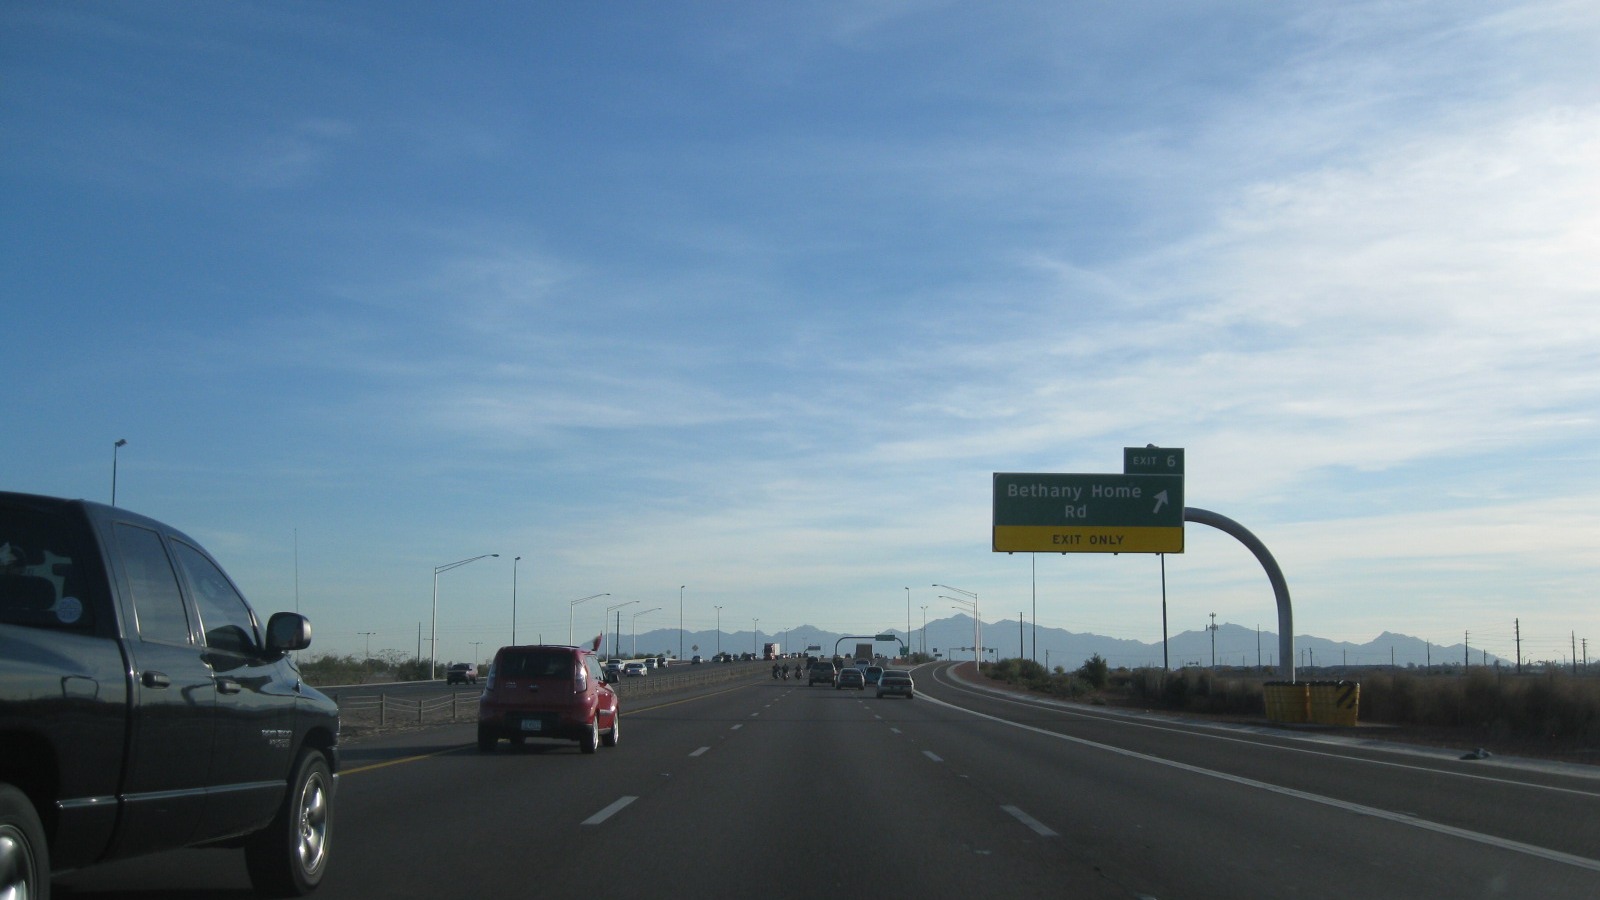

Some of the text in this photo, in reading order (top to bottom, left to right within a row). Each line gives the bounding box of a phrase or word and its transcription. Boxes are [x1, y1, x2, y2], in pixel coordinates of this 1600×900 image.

[1132, 455, 1176, 467] EXIT 6
[1007, 483, 1142, 501] Bethany Home
[1065, 505, 1087, 518] Rd
[1053, 534, 1124, 545] EXIT ONLY
